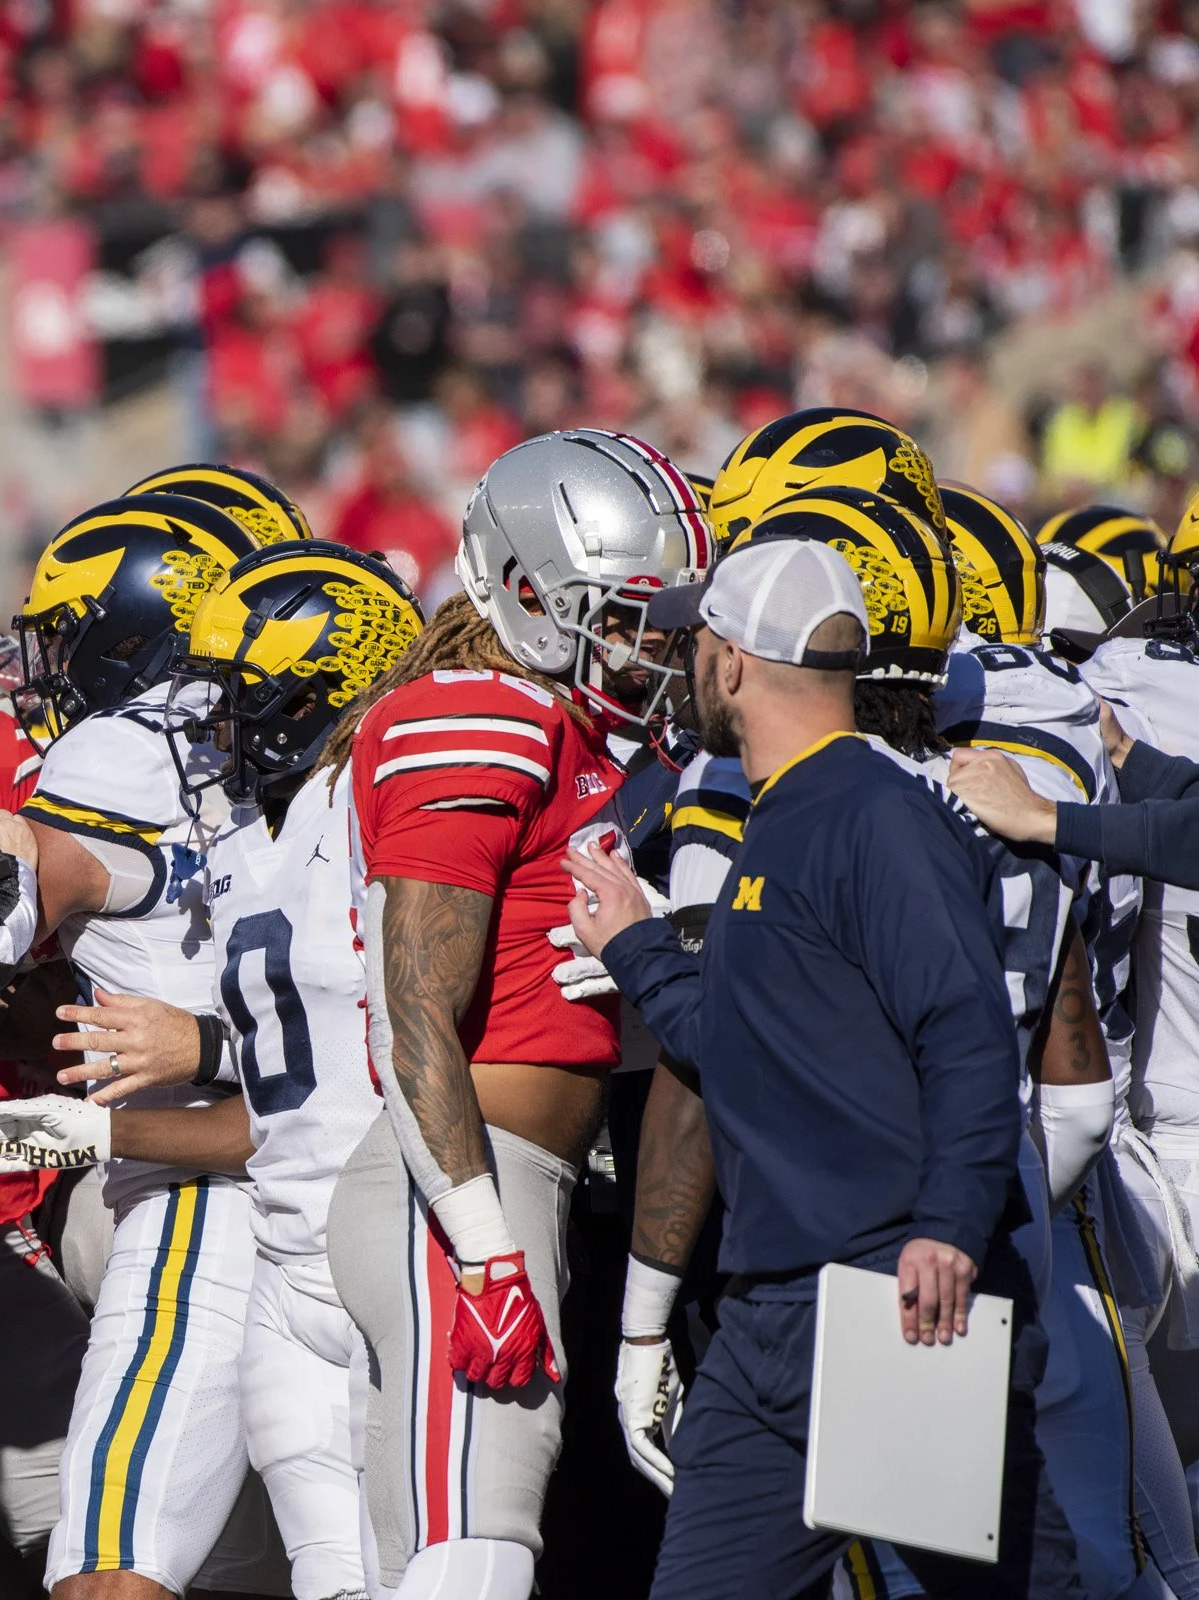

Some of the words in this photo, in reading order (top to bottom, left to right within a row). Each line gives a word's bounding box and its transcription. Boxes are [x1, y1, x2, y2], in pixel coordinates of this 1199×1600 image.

[186, 581, 205, 590] TED
[373, 599, 390, 607] TED
[891, 614, 908, 634] 19
[977, 617, 997, 635] 26
[731, 876, 765, 911] M
